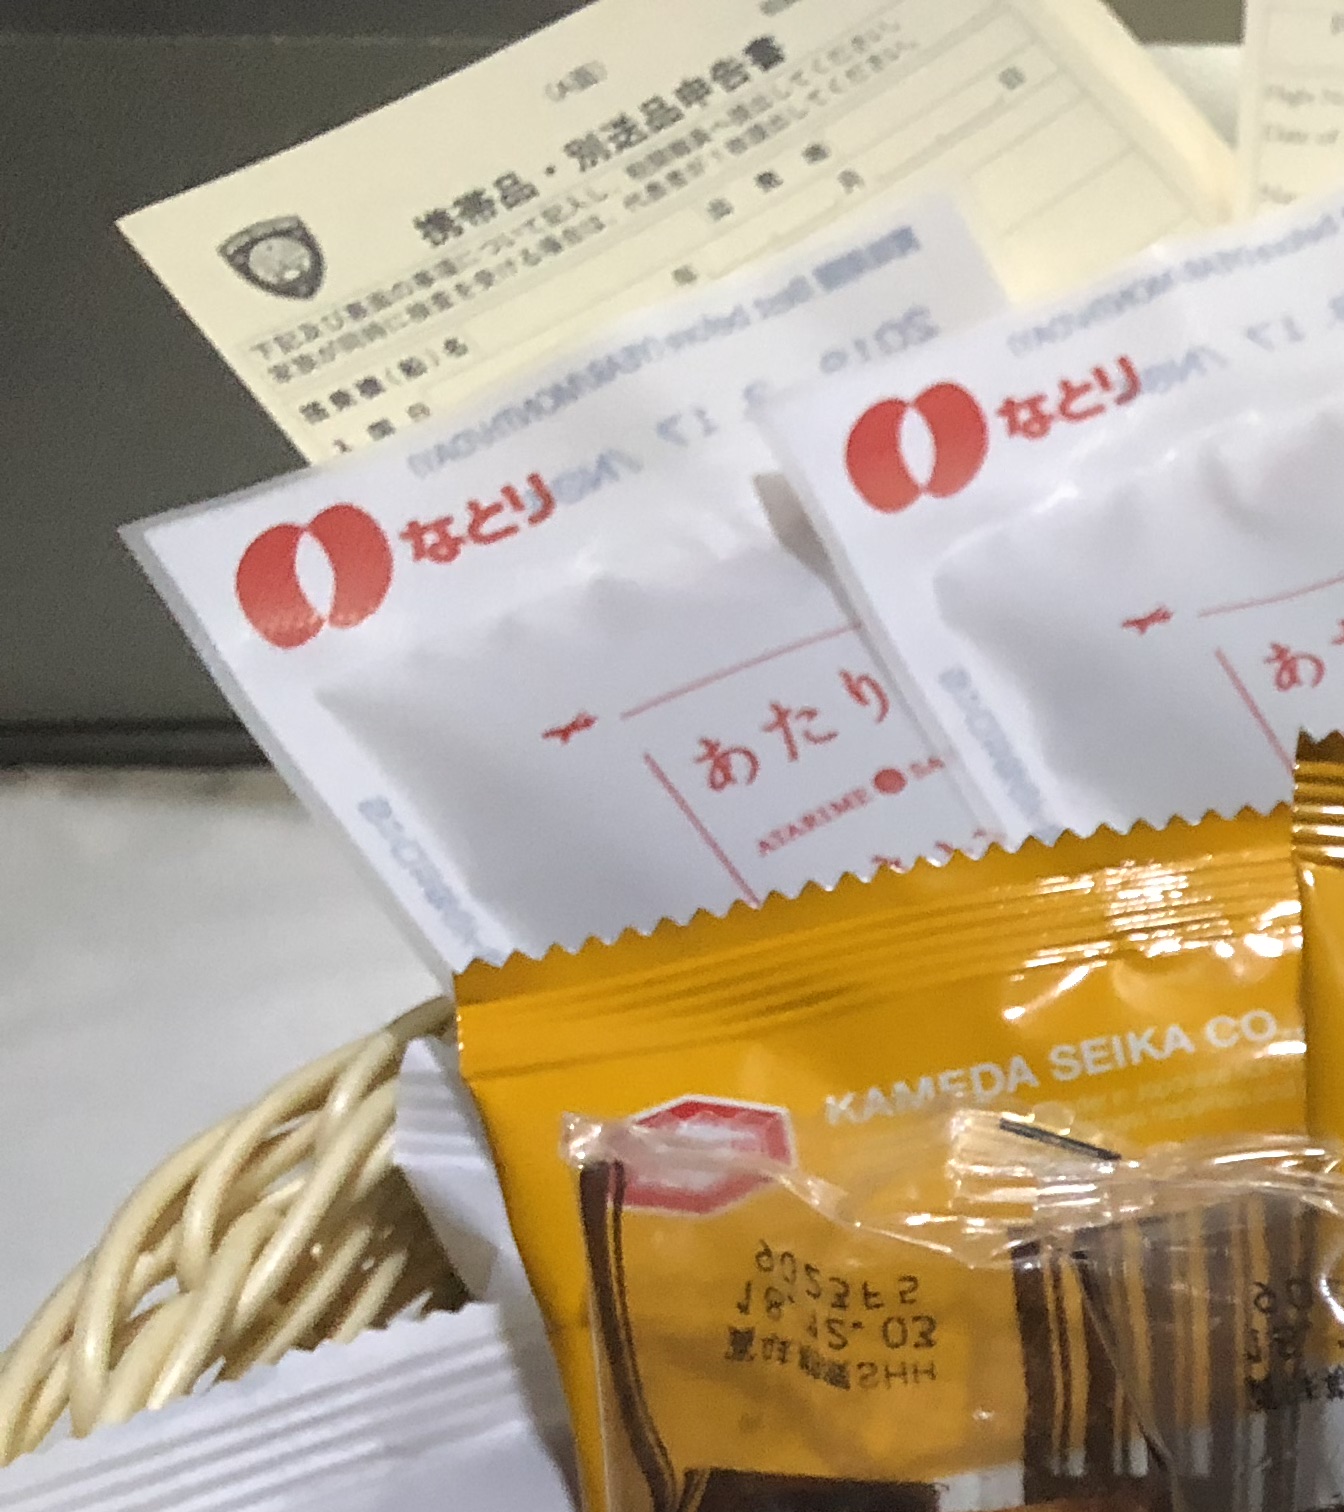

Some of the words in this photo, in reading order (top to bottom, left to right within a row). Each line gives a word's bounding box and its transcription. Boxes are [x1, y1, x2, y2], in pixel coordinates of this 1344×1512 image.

[995, 355, 1142, 439] なとり
[400, 472, 555, 564] なとり
[694, 666, 890, 792] あたり
[825, 1055, 1041, 1125] KAMEDA
[1048, 1022, 1195, 1080] SEIKA
